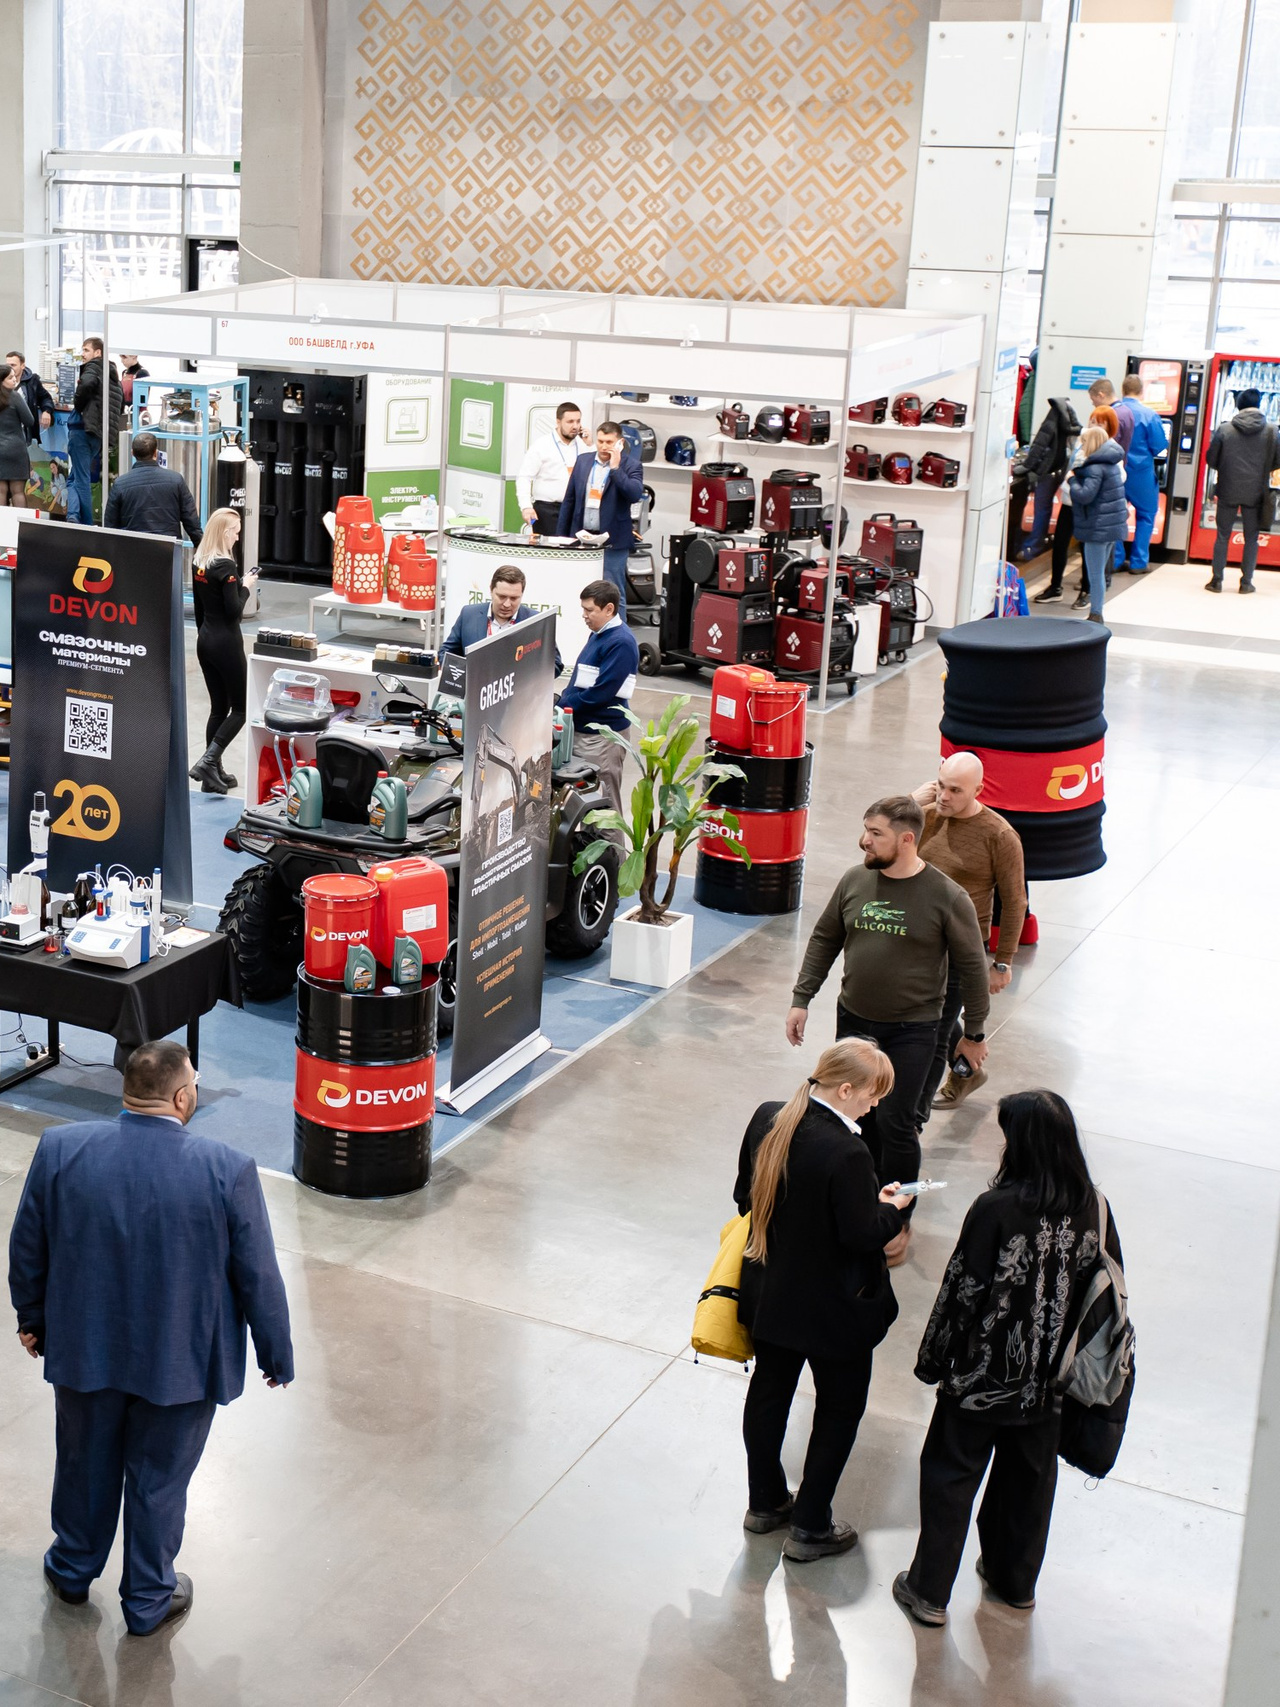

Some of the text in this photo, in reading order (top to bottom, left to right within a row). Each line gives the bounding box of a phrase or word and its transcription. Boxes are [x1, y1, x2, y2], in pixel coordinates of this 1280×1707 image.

[288, 336, 304, 346] ООО
[306, 337, 347, 350] БАШВЕЛД
[385, 377, 432, 386] ОБОРУДОВАНИЕ
[381, 494, 423, 504] ИНСТРУМЕНТ
[390, 486, 420, 494] ЭЛЕКТРО-
[49, 593, 138, 626] DEVON
[38, 630, 147, 657] смазочные
[52, 647, 131, 667] материалы
[57, 658, 124, 675] ПРЕМИУМ-СЕГМЕНТА
[66, 687, 114, 700] www.devongroup.ru
[480, 672, 515, 711] GREASE
[51, 779, 121, 842] 20
[84, 806, 109, 820] лет
[481, 837, 527, 871] ПРОИЗВОДСТВО
[471, 853, 533, 897] ПЛАСТИЧНЫХ СМАЗОК
[328, 929, 369, 941] DEVON
[854, 918, 908, 937] LACOSTE
[472, 947, 484, 961] Shell
[487, 937, 499, 951] Mobil
[501, 928, 512, 941] Total
[355, 1081, 427, 1106] DEVON
